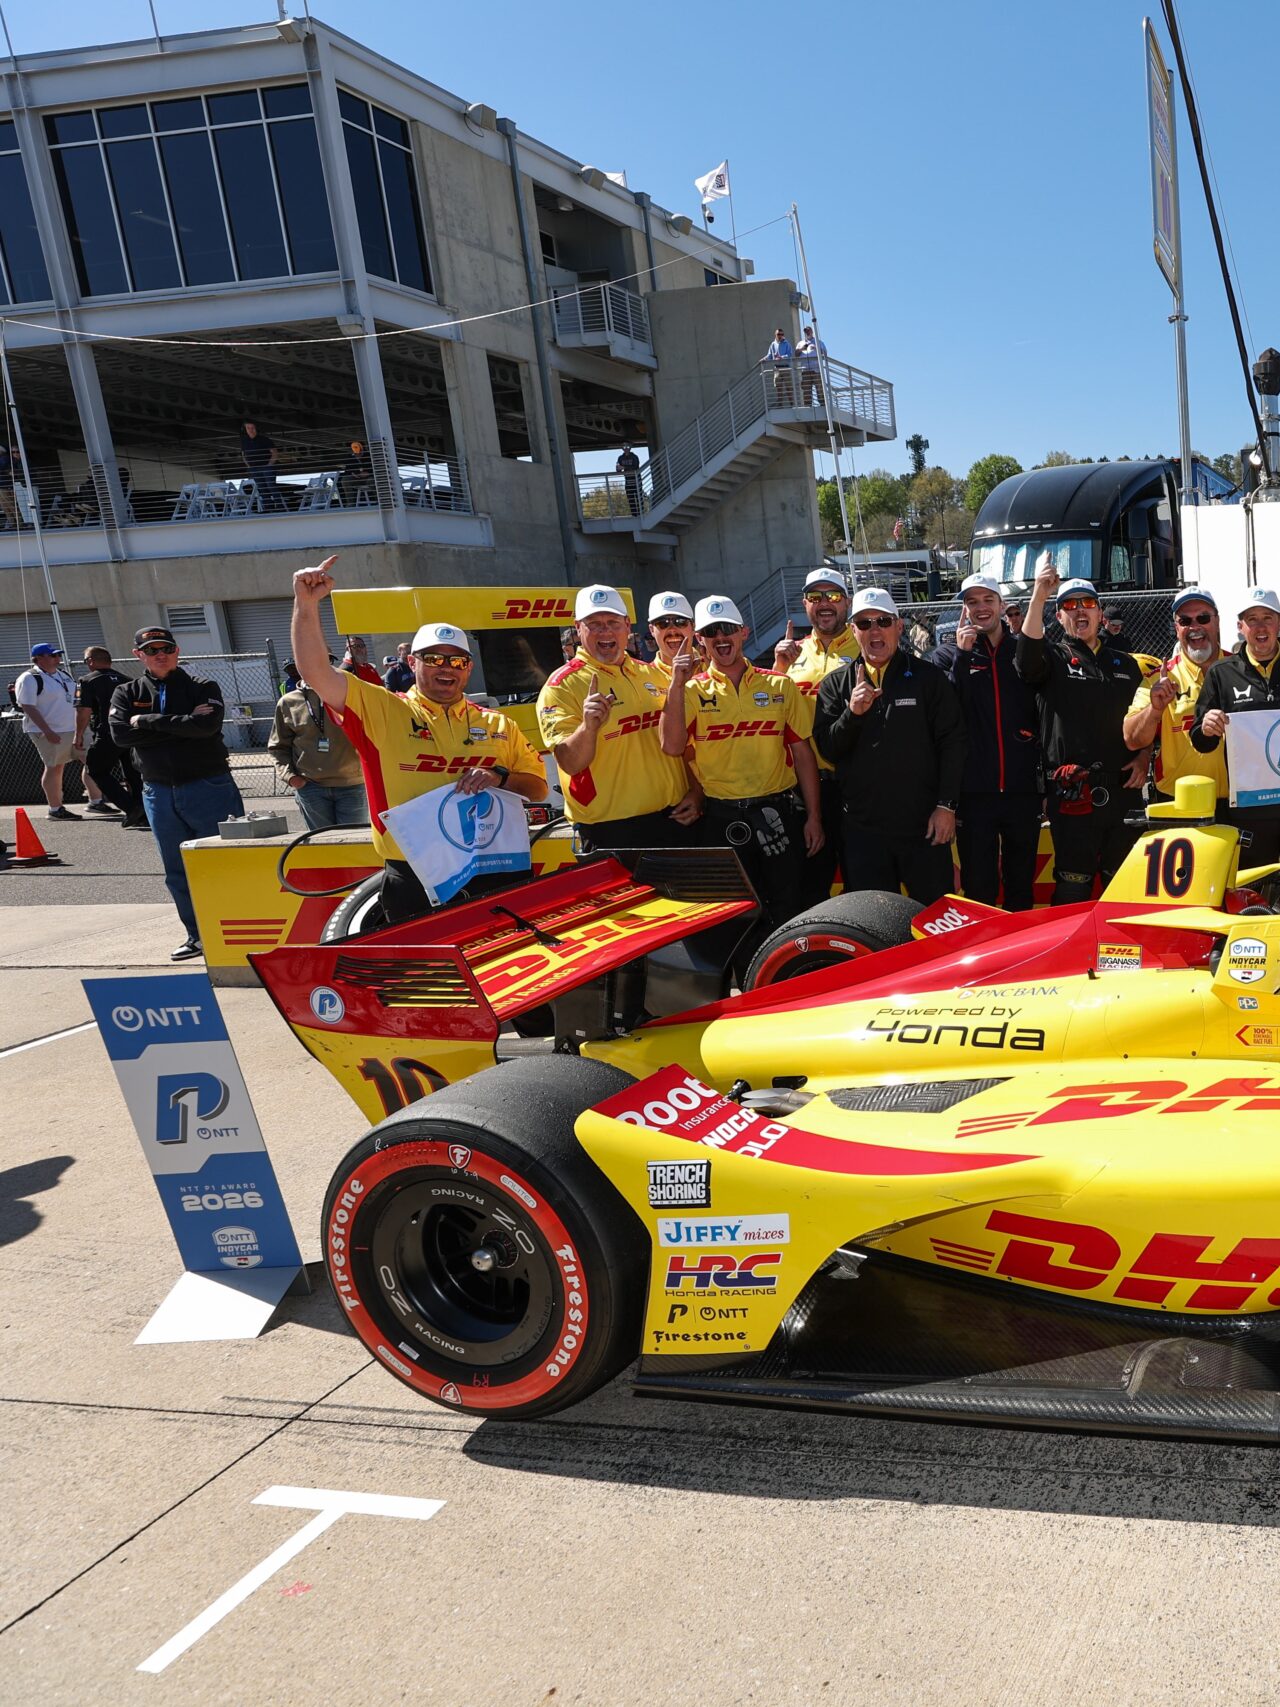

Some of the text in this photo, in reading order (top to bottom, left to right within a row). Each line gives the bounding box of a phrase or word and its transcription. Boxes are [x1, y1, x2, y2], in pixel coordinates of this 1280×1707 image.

[504, 598, 573, 619] DHL
[617, 709, 664, 736] DH
[706, 720, 782, 741] DHL
[1144, 838, 1195, 899] 10
[560, 899, 600, 915] WITH
[1106, 946, 1135, 956] DHL
[1243, 945, 1264, 954] NTT
[1107, 957, 1140, 966] GANASSI
[1229, 957, 1267, 966] INDYCAR
[976, 985, 1064, 998] PNC BANK
[876, 1006, 1022, 1018] Powered by
[1238, 998, 1258, 1010] PPG
[146, 1006, 202, 1028] NTT
[861, 1019, 1046, 1051] Honda
[678, 1096, 731, 1131] Insurance
[213, 1127, 239, 1138] NTT
[647, 1164, 707, 1184] TRENCH
[221, 1182, 257, 1190] AWARD
[502, 1176, 536, 1207] ENLITEN
[647, 1183, 707, 1200] SHORING
[181, 1191, 264, 1212] 2026
[431, 1188, 485, 1206] RACING
[231, 1233, 251, 1242] NTT
[743, 1227, 785, 1241] mixes
[217, 1243, 259, 1253] INDYCAR
[330, 1179, 365, 1312] Firestone
[665, 1252, 783, 1290] HRC
[665, 1288, 777, 1297] Honda RACING
[546, 1244, 583, 1377] Firestone
[718, 1307, 749, 1319] NTT
[414, 1322, 466, 1354] RACING
[653, 1330, 748, 1343] Firestone
